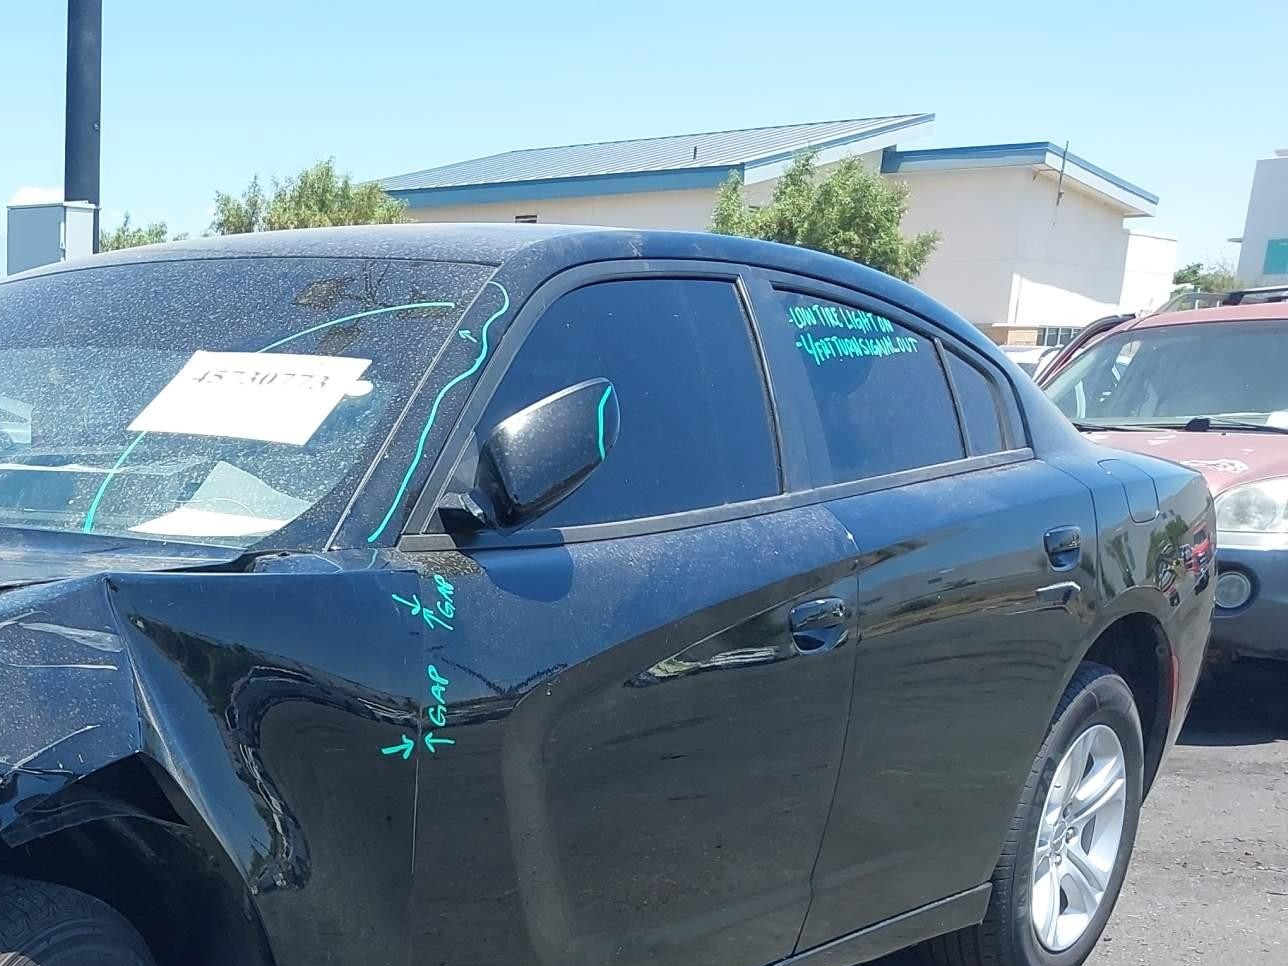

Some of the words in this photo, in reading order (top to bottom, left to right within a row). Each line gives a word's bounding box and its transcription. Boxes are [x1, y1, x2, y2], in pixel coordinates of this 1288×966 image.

[838, 306, 879, 335] LIGHT
[876, 315, 895, 334] ON
[895, 335, 919, 353] OUT
[433, 574, 457, 619] GAP
[427, 664, 452, 728] GAP
